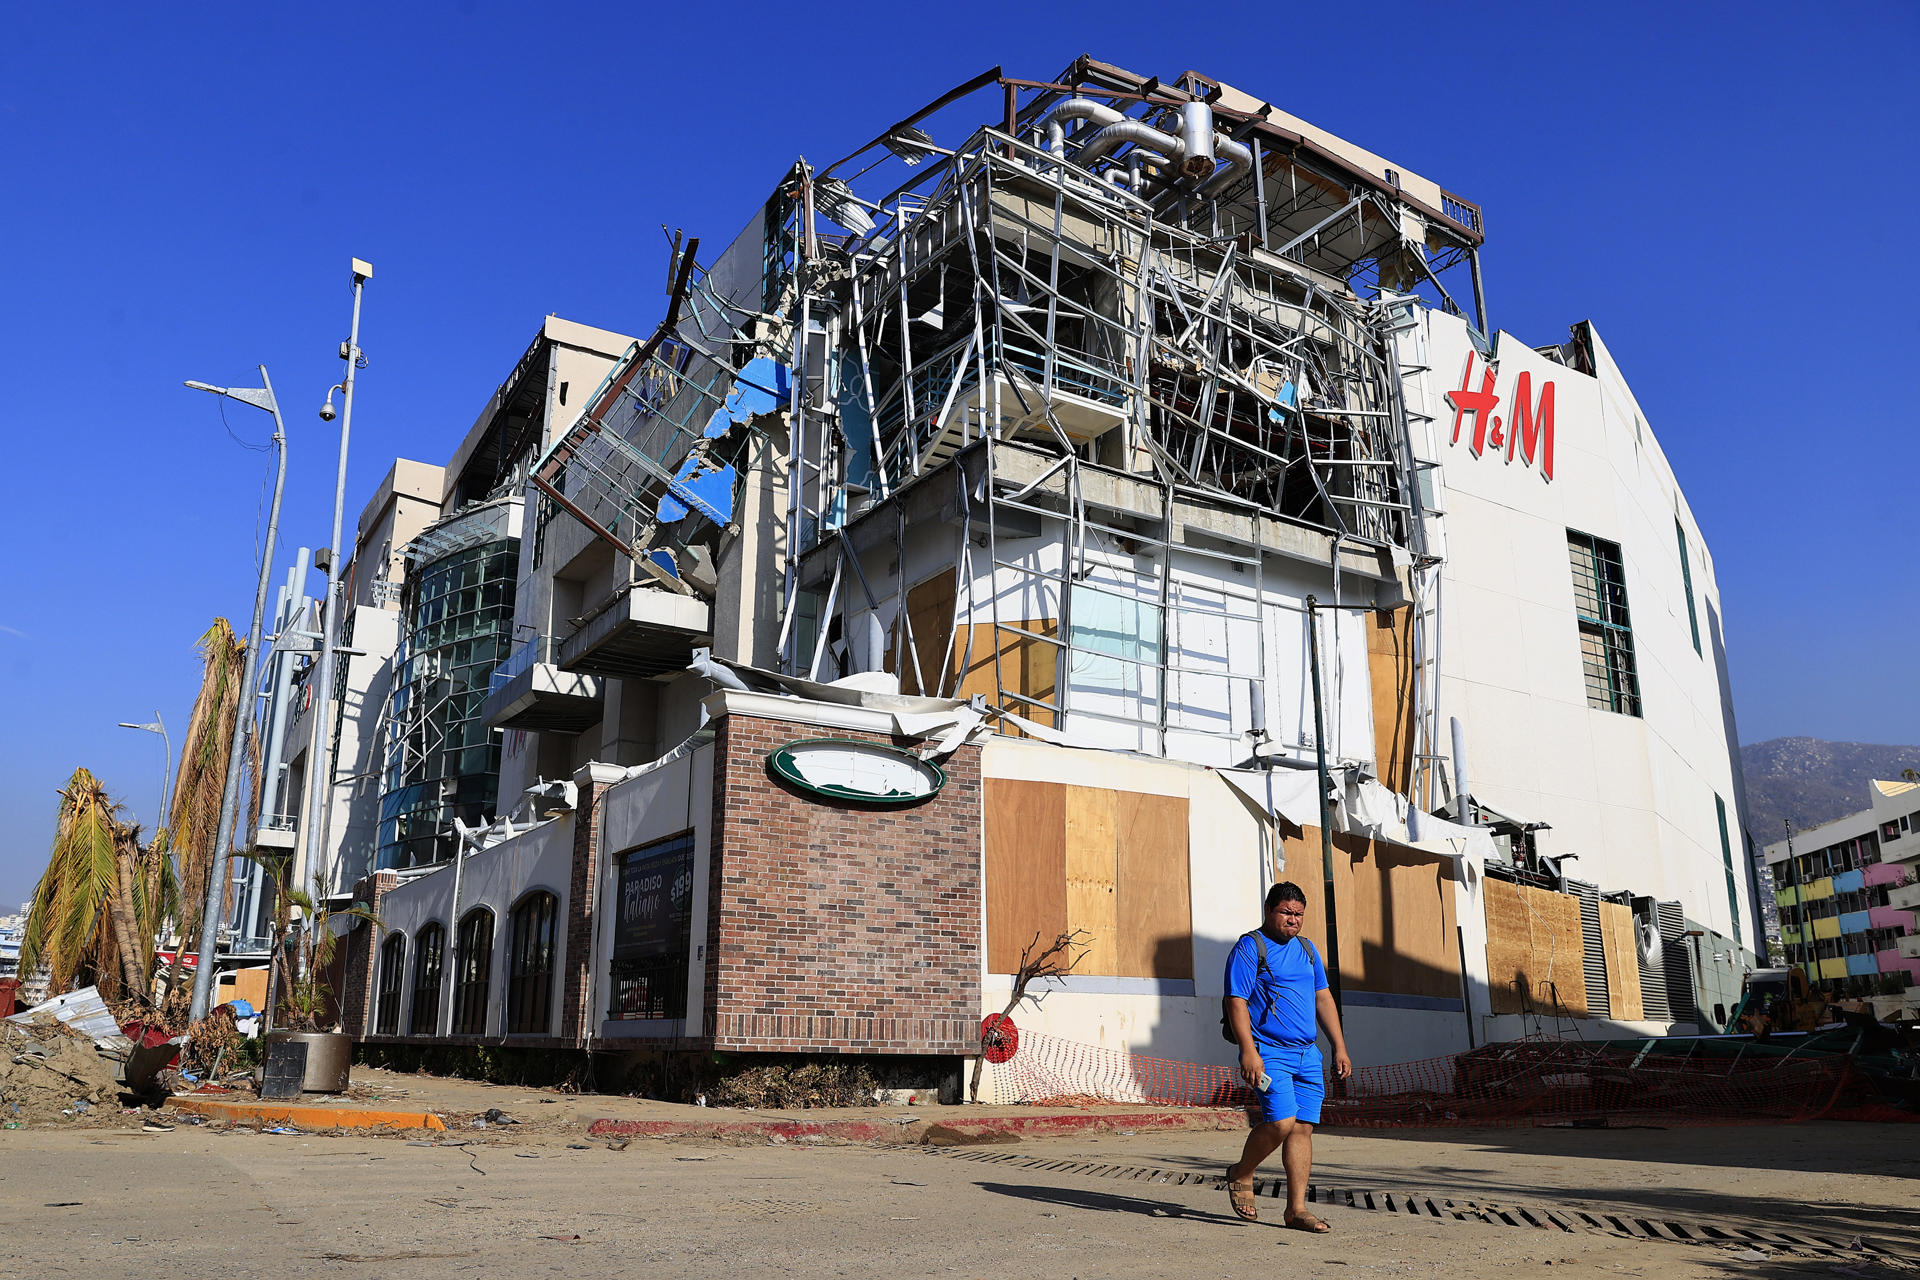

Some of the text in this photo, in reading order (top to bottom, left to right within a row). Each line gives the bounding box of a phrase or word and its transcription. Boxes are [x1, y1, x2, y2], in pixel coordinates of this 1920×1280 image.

[1444, 349, 1555, 484] H&M
[625, 874, 662, 896] PARADISO
[671, 871, 692, 904] $199
